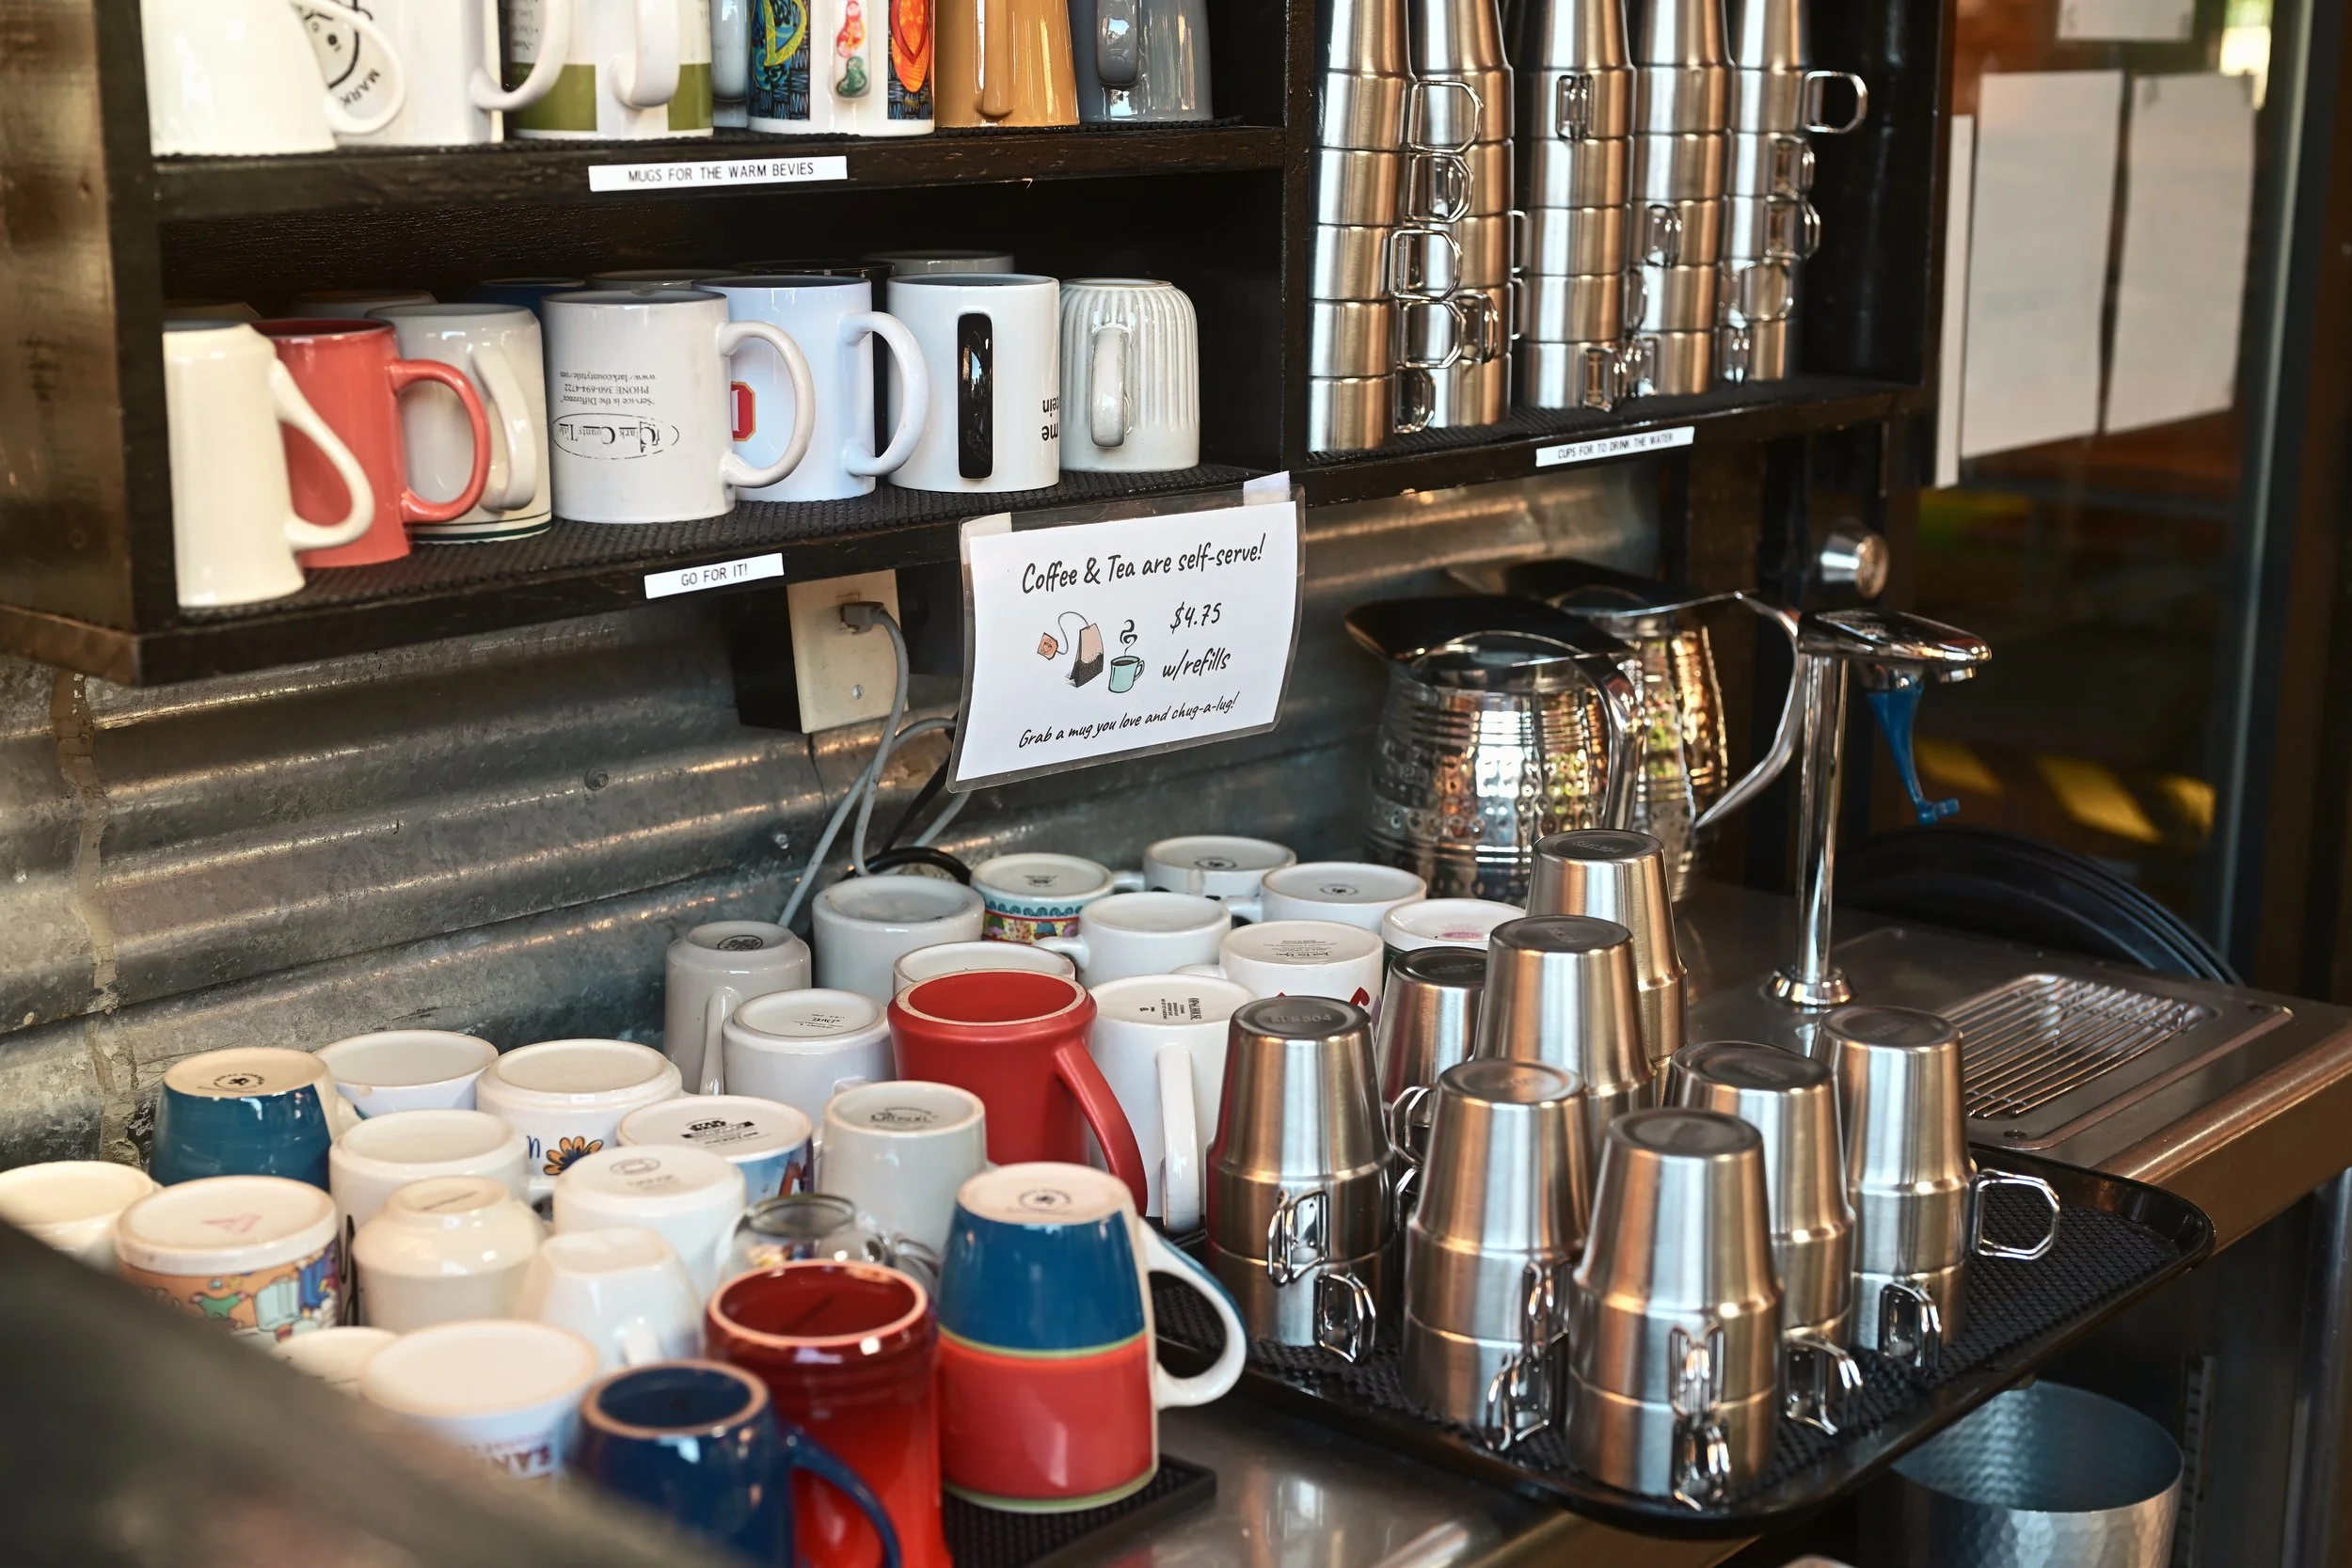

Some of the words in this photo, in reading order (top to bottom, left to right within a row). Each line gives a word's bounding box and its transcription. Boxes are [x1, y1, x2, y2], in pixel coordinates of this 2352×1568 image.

[628, 168, 662, 182] MUGS
[668, 167, 692, 181] FOR
[701, 166, 723, 180] THE
[729, 164, 767, 178] WARM
[772, 162, 815, 176] BEVIES
[564, 383, 613, 394] 360-694-4722
[616, 386, 649, 394] PHONE
[598, 397, 612, 406] the
[612, 398, 621, 406] is
[559, 424, 579, 441] Title
[578, 426, 615, 445] County
[1558, 447, 1576, 459] CUPS
[1579, 445, 1594, 457] FOR
[1597, 443, 1607, 452] TO
[1610, 439, 1629, 451] DRINK
[1633, 436, 1645, 448] THE
[1650, 433, 1674, 444] WATER
[1022, 562, 1077, 594] Coffee
[1083, 557, 1101, 585] &
[1107, 554, 1136, 582] Tea
[1141, 556, 1172, 575] are
[1178, 532, 1266, 572] self-serve!
[681, 572, 698, 586] GO
[704, 567, 727, 582] FOR
[733, 562, 748, 578] IT!
[1169, 601, 1222, 634] $4.75
[1162, 647, 1232, 681] w/refills
[1019, 726, 1053, 749] Grab
[1056, 730, 1065, 740] a
[1068, 724, 1093, 739] mug
[1092, 721, 1116, 738] you
[1119, 712, 1142, 729] love
[1144, 706, 1170, 724] and
[1171, 691, 1241, 720] chug-a-lug!
